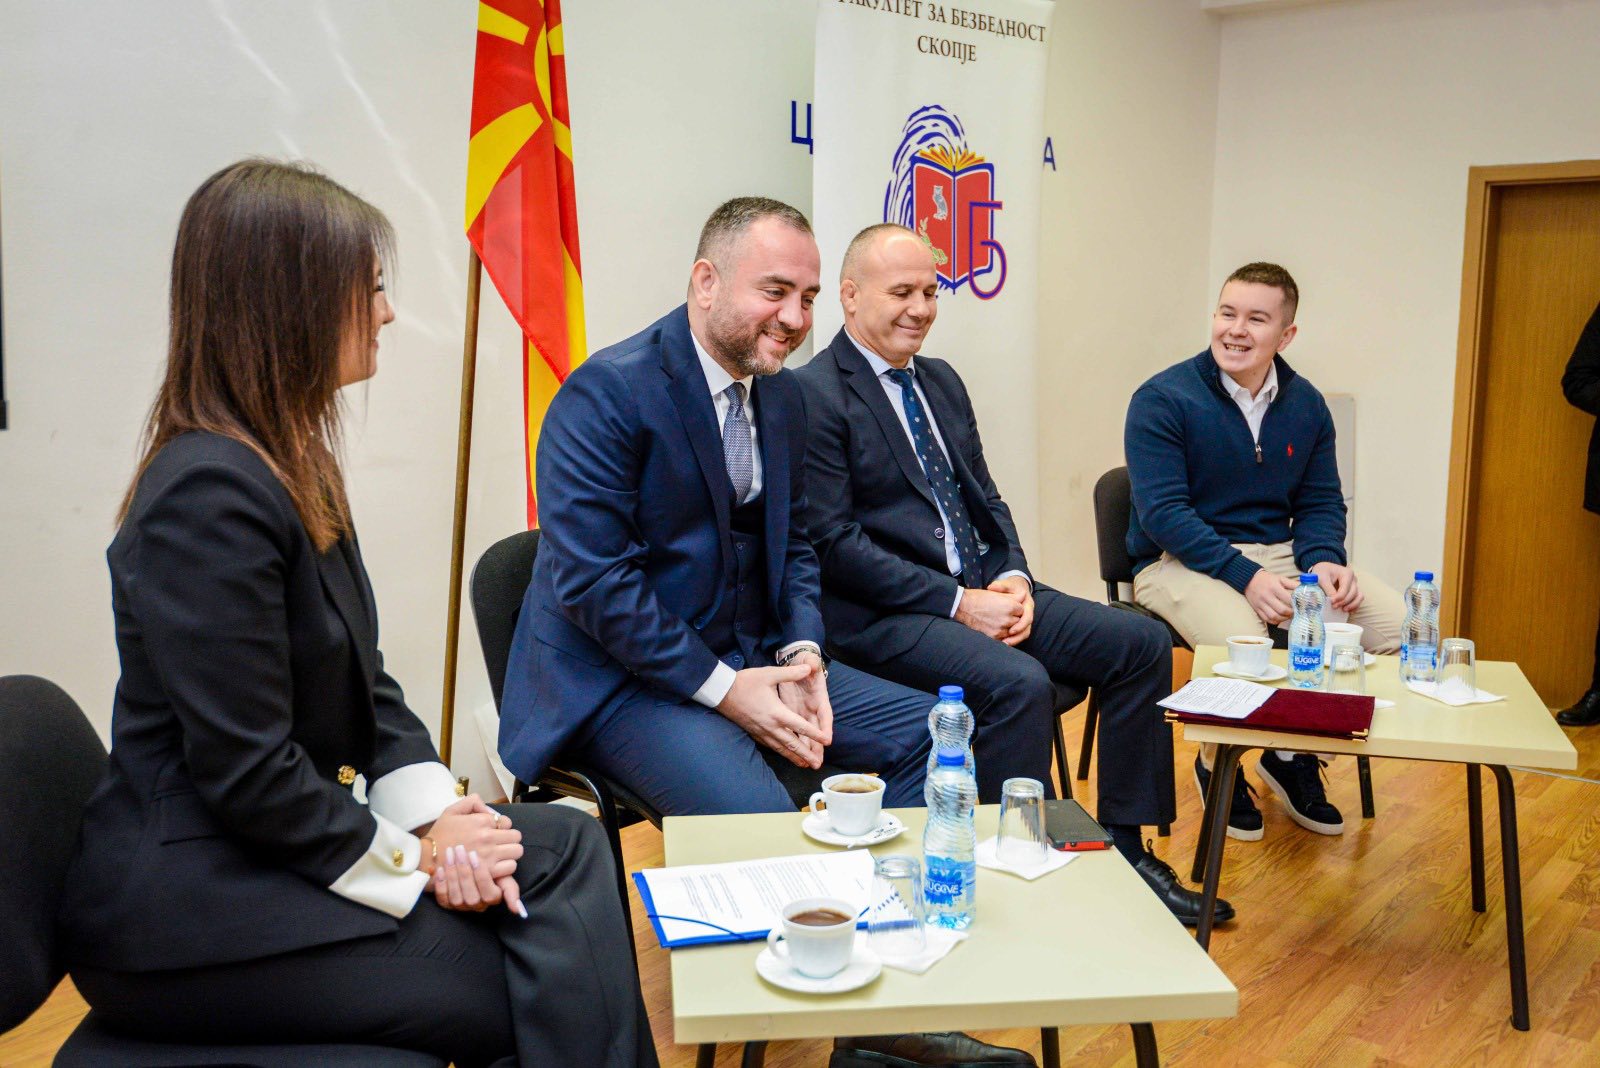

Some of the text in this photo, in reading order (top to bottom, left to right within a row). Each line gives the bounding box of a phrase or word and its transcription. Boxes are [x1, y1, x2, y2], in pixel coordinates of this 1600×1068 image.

[838, 0, 1046, 42] УЛТЕТ ЗА БЕЗБЕДНОСТ
[917, 35, 977, 65] СКОПЈЕ
